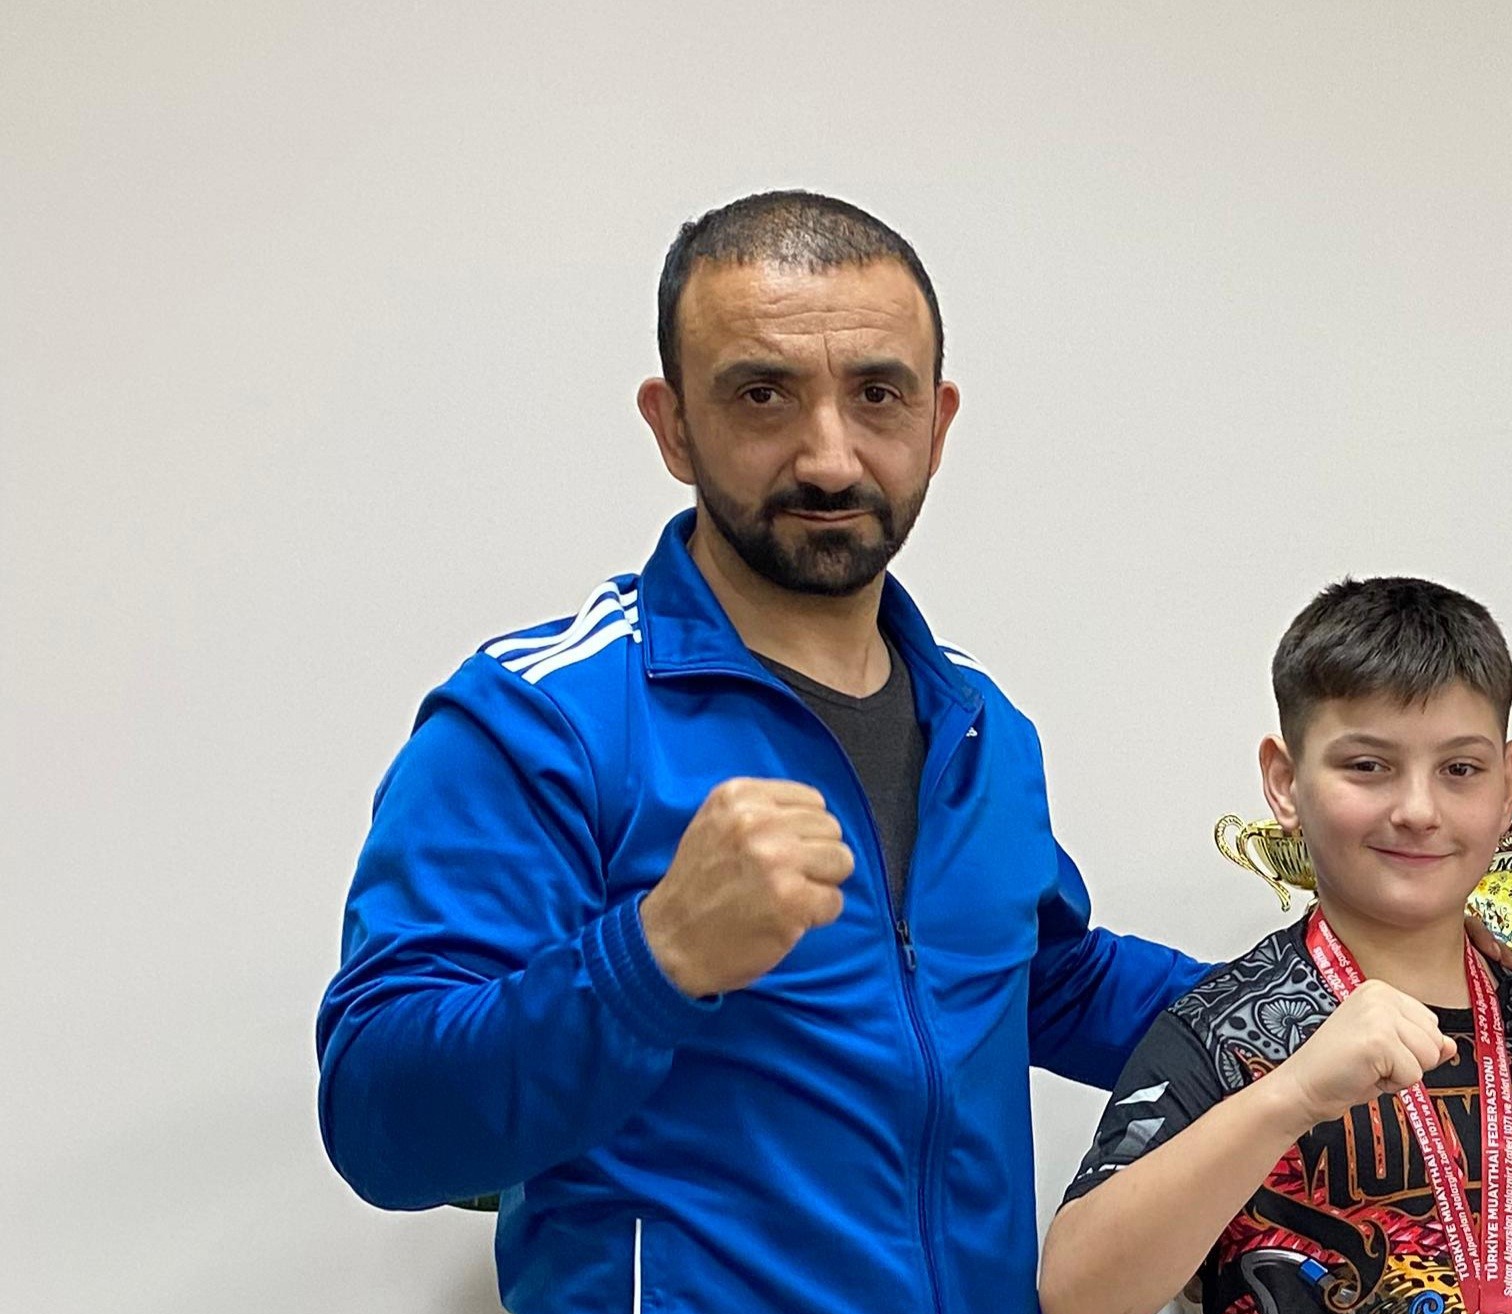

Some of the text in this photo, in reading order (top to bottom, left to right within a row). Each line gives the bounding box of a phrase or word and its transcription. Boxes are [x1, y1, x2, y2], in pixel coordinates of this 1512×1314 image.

[1483, 1056, 1499, 1147] FEDERASYONU
[1503, 1103, 1512, 1114] ve
[1446, 1223, 1469, 1281] TÜRKİYE
[1485, 1222, 1499, 1281] TÜRKİYE
